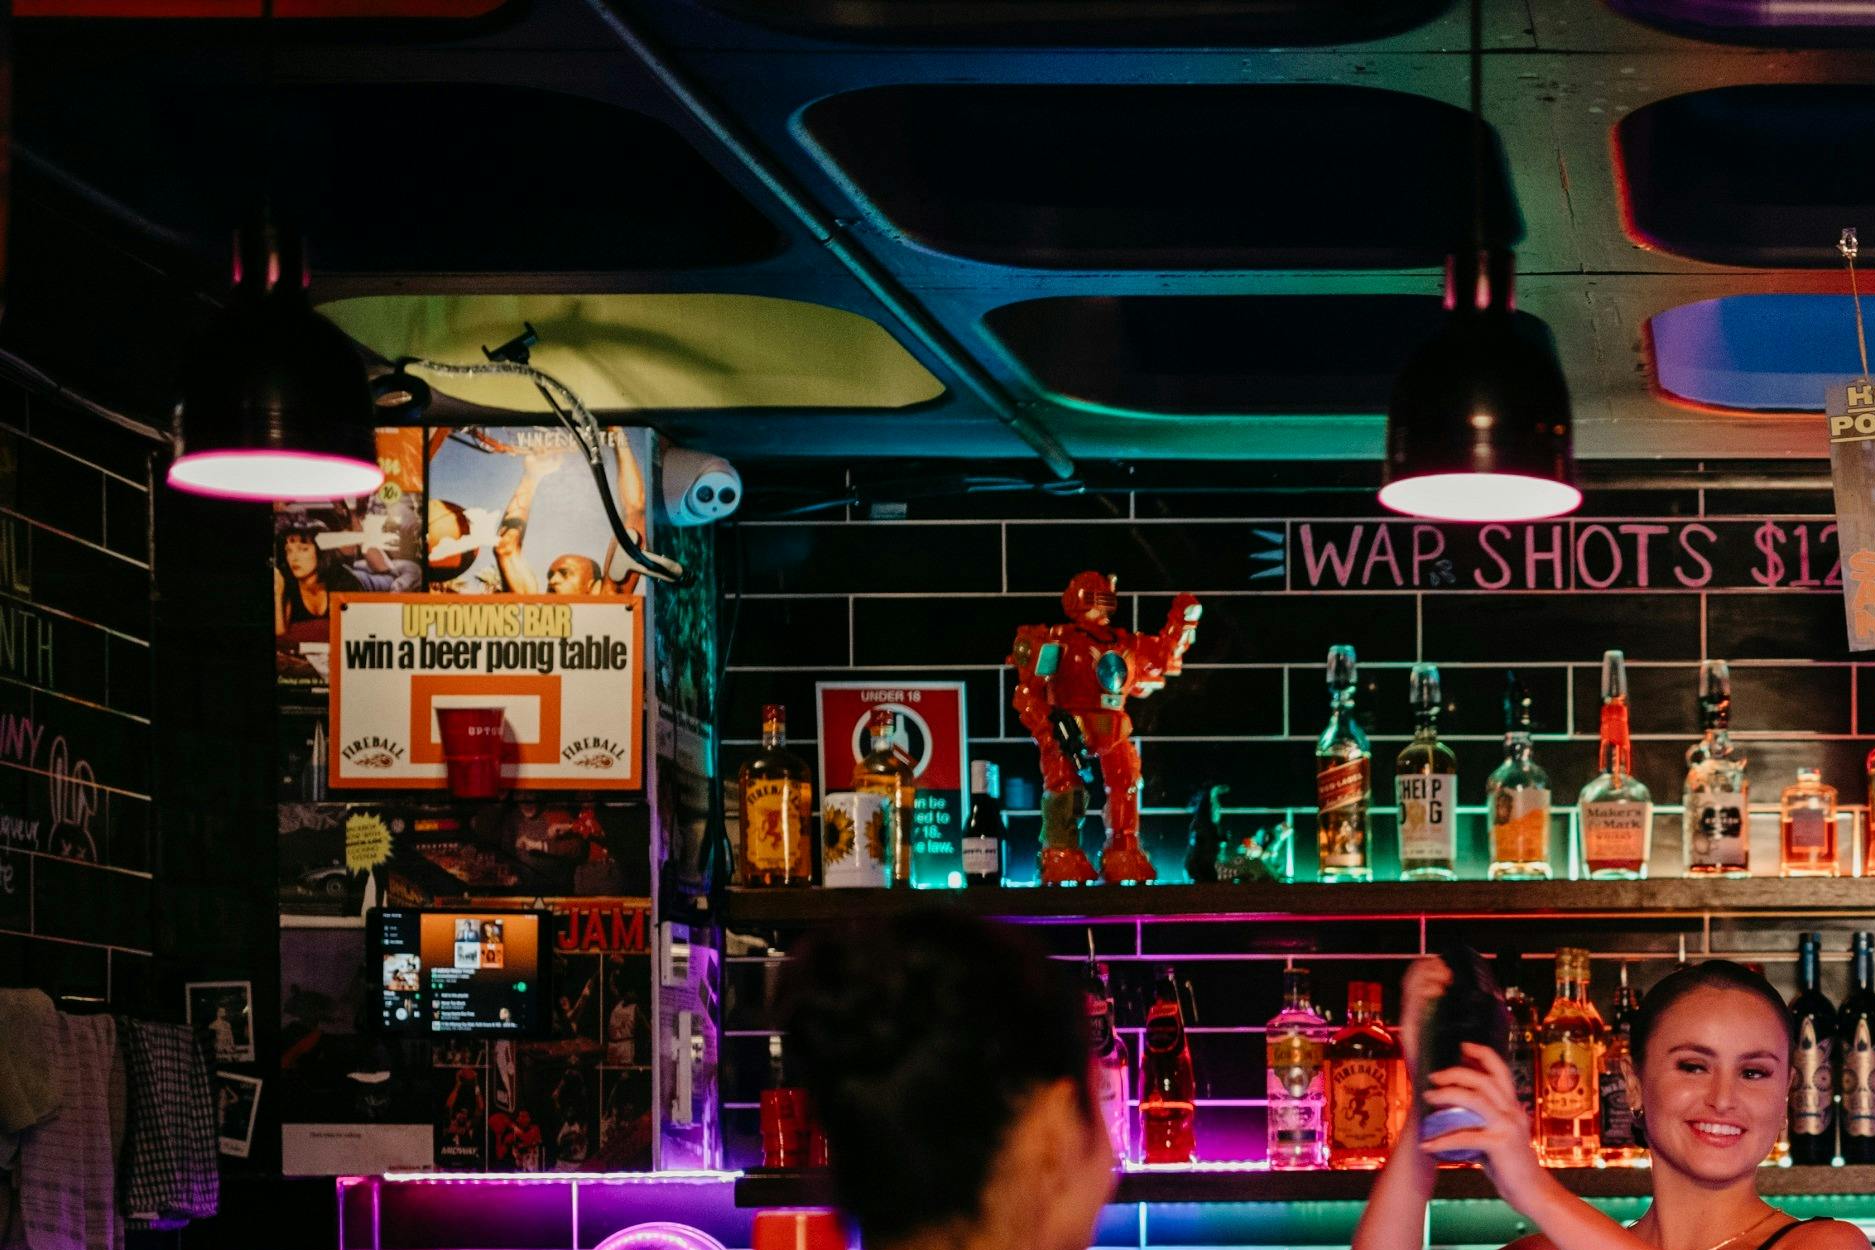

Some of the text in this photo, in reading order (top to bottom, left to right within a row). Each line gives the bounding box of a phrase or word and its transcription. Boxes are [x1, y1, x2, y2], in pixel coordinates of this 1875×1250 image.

[567, 431, 625, 448] CTER
[1300, 524, 1445, 586] WAP
[1473, 523, 1718, 589] SHOTS
[402, 603, 573, 638] UPTOWNS BAR
[345, 634, 627, 674] win a beer pong table
[861, 690, 922, 702] UNDER 18
[341, 736, 407, 760] FIREBALL
[561, 736, 626, 761] FIREBALL
[1603, 820, 1641, 829] Mark
[557, 906, 646, 951] JAM
[1333, 1064, 1386, 1084] FIREBALL
